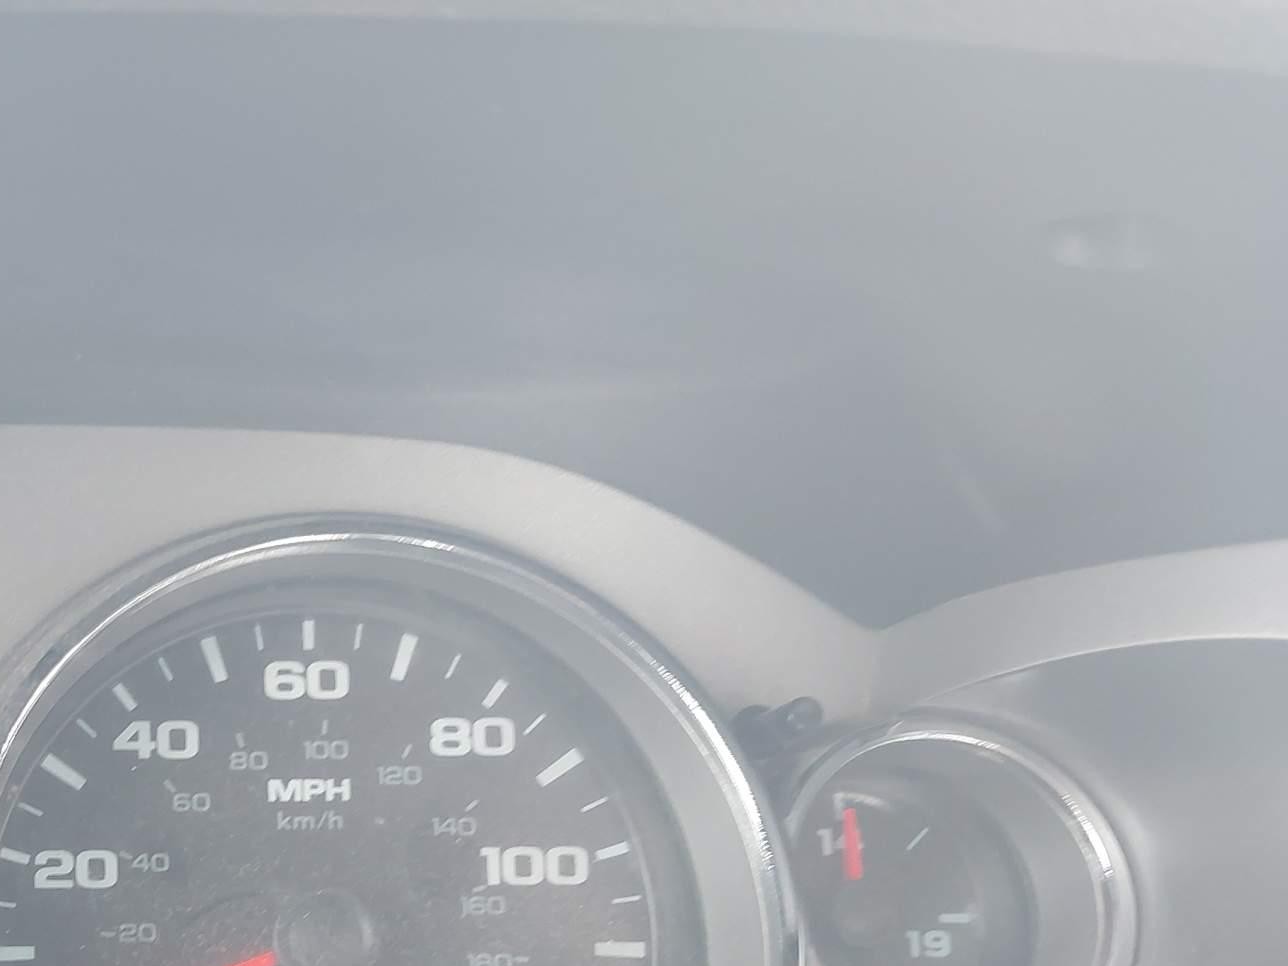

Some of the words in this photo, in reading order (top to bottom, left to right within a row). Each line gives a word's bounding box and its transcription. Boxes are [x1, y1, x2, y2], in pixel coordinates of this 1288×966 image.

[264, 660, 350, 700] 60
[113, 720, 199, 759] 40
[429, 717, 515, 757] 80
[304, 740, 349, 760] 100
[229, 751, 268, 771] 80
[377, 766, 423, 787] 120
[267, 779, 351, 801] MPH
[173, 792, 211, 812] 60
[276, 810, 344, 831] km/h
[432, 817, 477, 837] 140
[34, 850, 118, 888] 20
[130, 853, 169, 872] 40
[480, 846, 589, 886] 100
[119, 923, 157, 942] 20
[905, 930, 951, 957] 19
